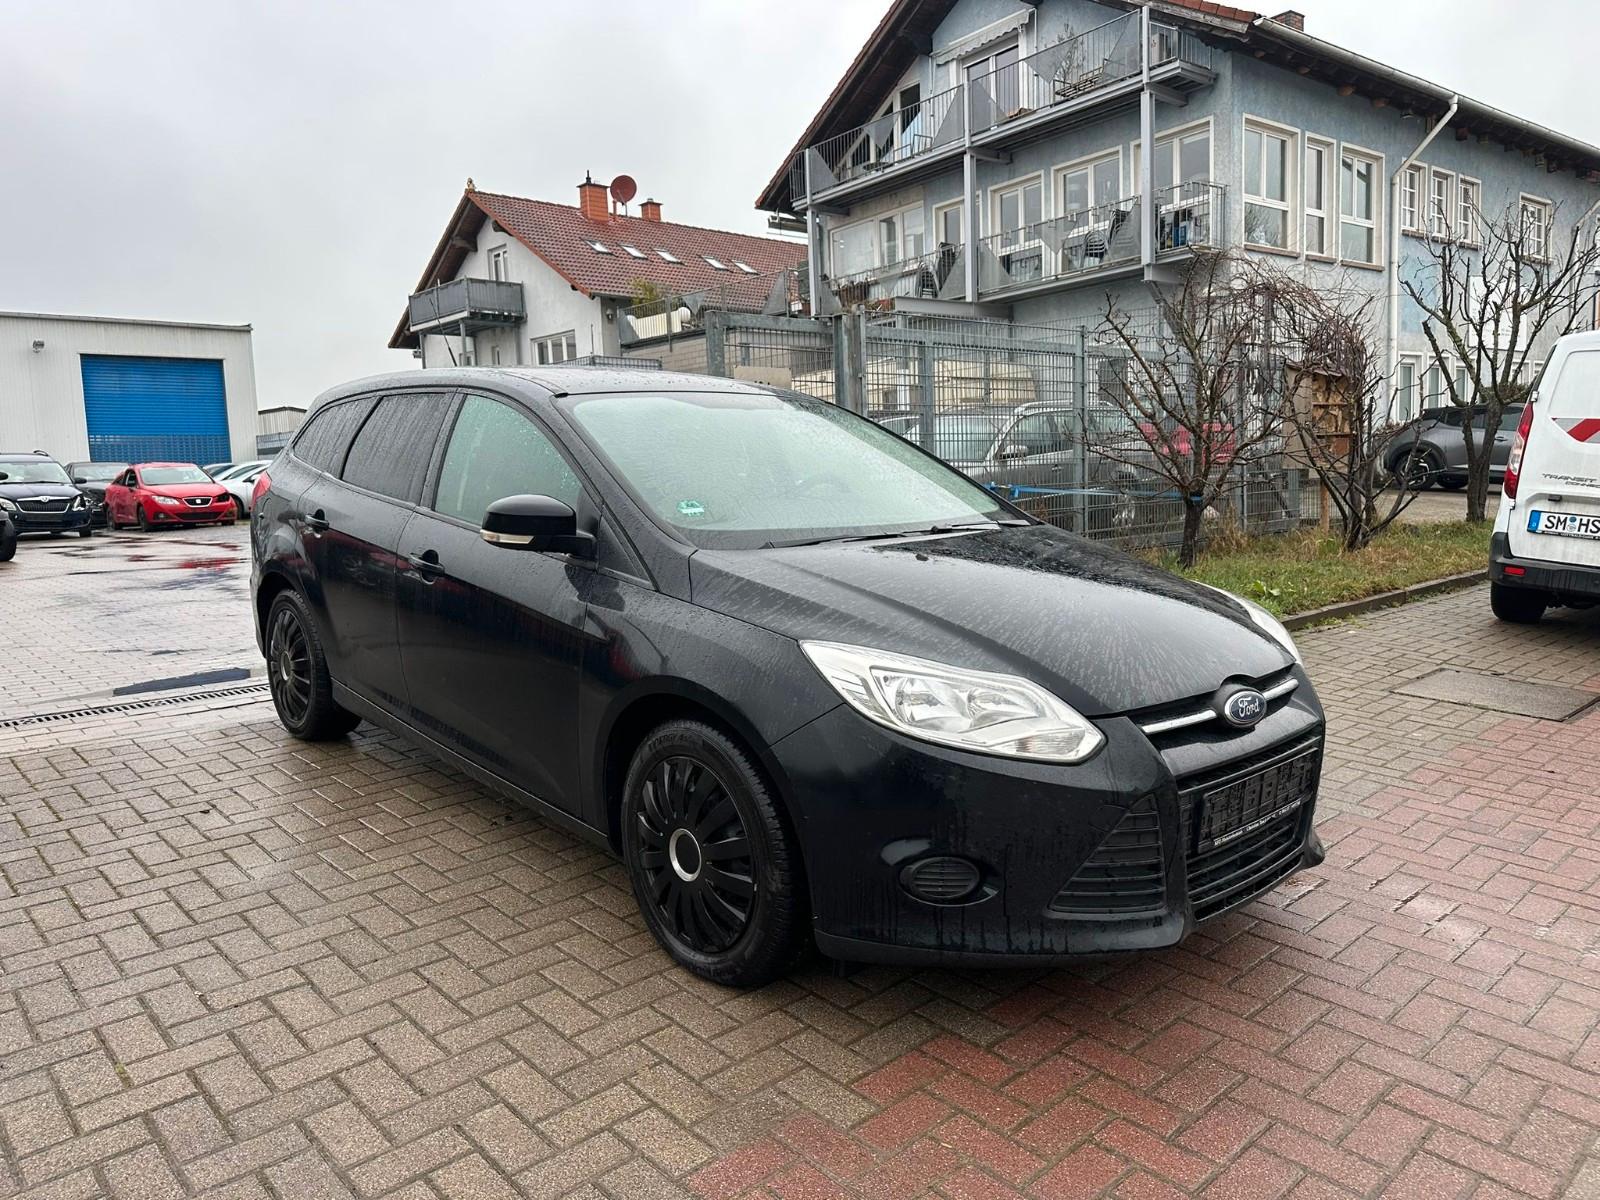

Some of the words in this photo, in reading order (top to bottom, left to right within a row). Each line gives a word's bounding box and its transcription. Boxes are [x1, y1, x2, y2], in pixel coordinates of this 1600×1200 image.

[1542, 473, 1598, 483] TRANSIT
[1545, 515, 1568, 531] SM
[1577, 518, 1600, 534] HS
[1238, 696, 1260, 718] Ford
